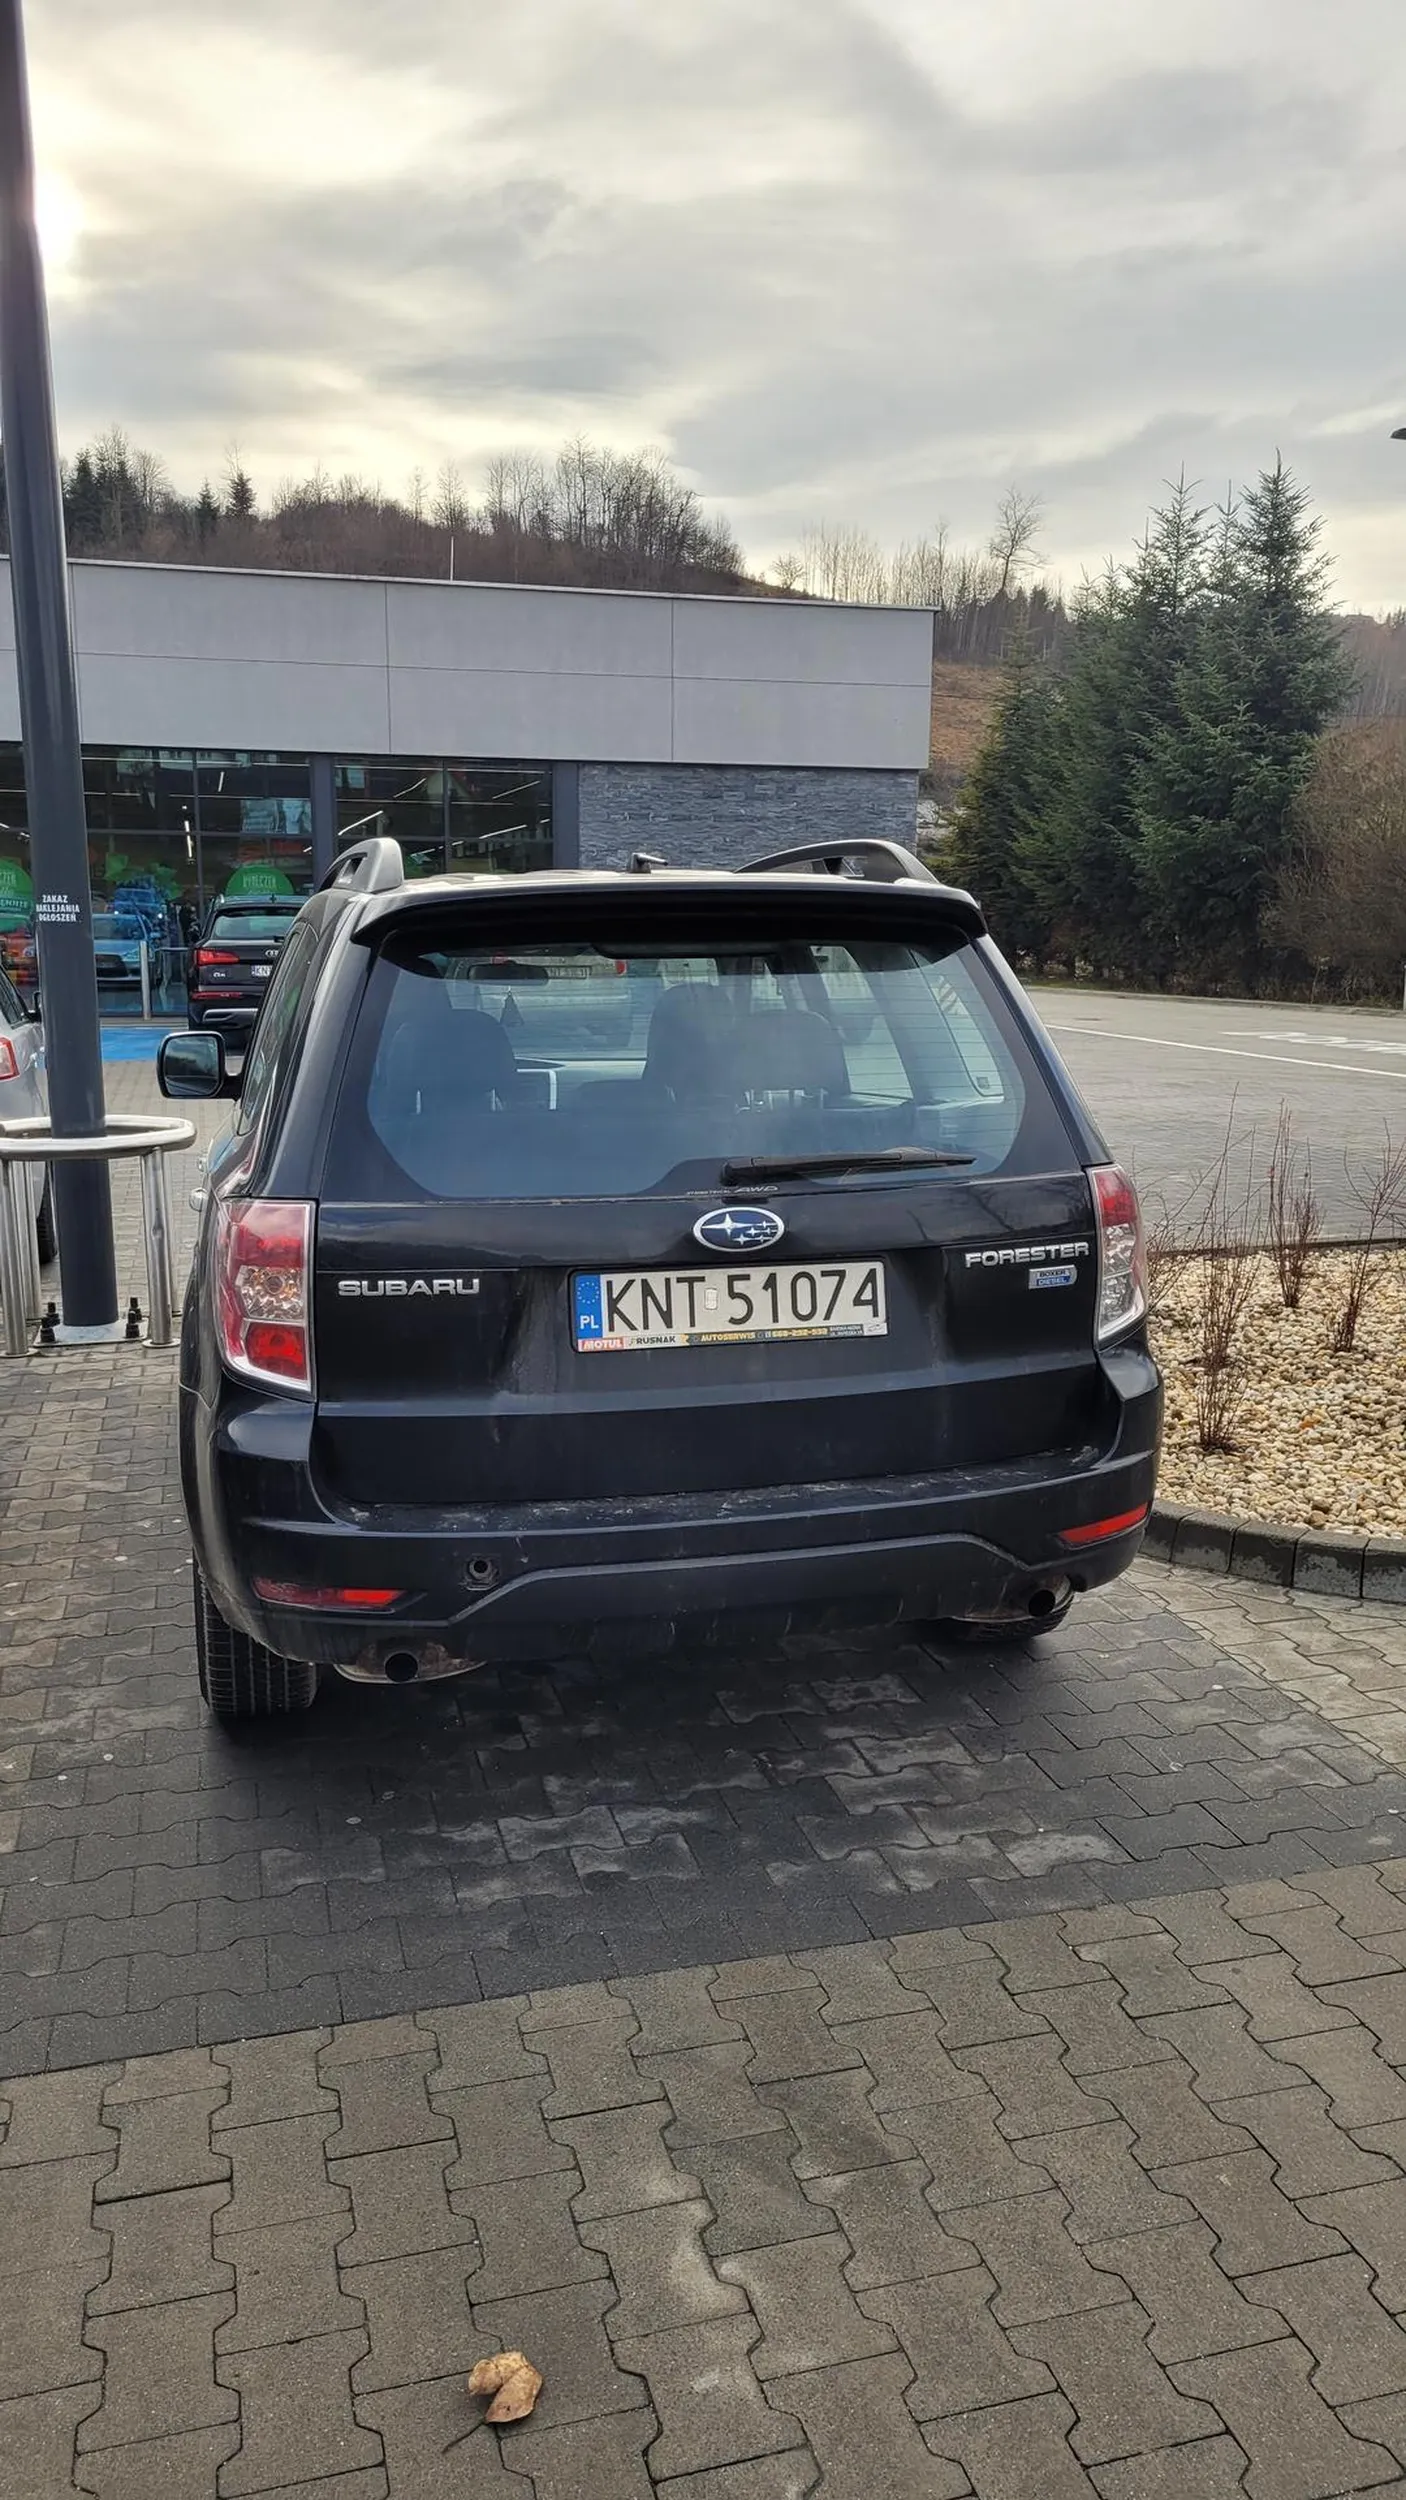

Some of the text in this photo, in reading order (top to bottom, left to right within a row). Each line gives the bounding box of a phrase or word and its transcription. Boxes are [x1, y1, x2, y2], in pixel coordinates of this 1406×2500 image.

[42, 895, 68, 903] ZAKAZ
[734, 1185, 779, 1194] AWD
[965, 1242, 1089, 1268] FORESTER
[338, 1278, 480, 1296] SUBARU
[606, 1268, 880, 1332] KNT 51074
[579, 1315, 599, 1330] PL
[583, 1338, 622, 1350] MOTUL
[636, 1335, 676, 1345] RUSNAK
[701, 1331, 756, 1342] AUTOSERWIS
